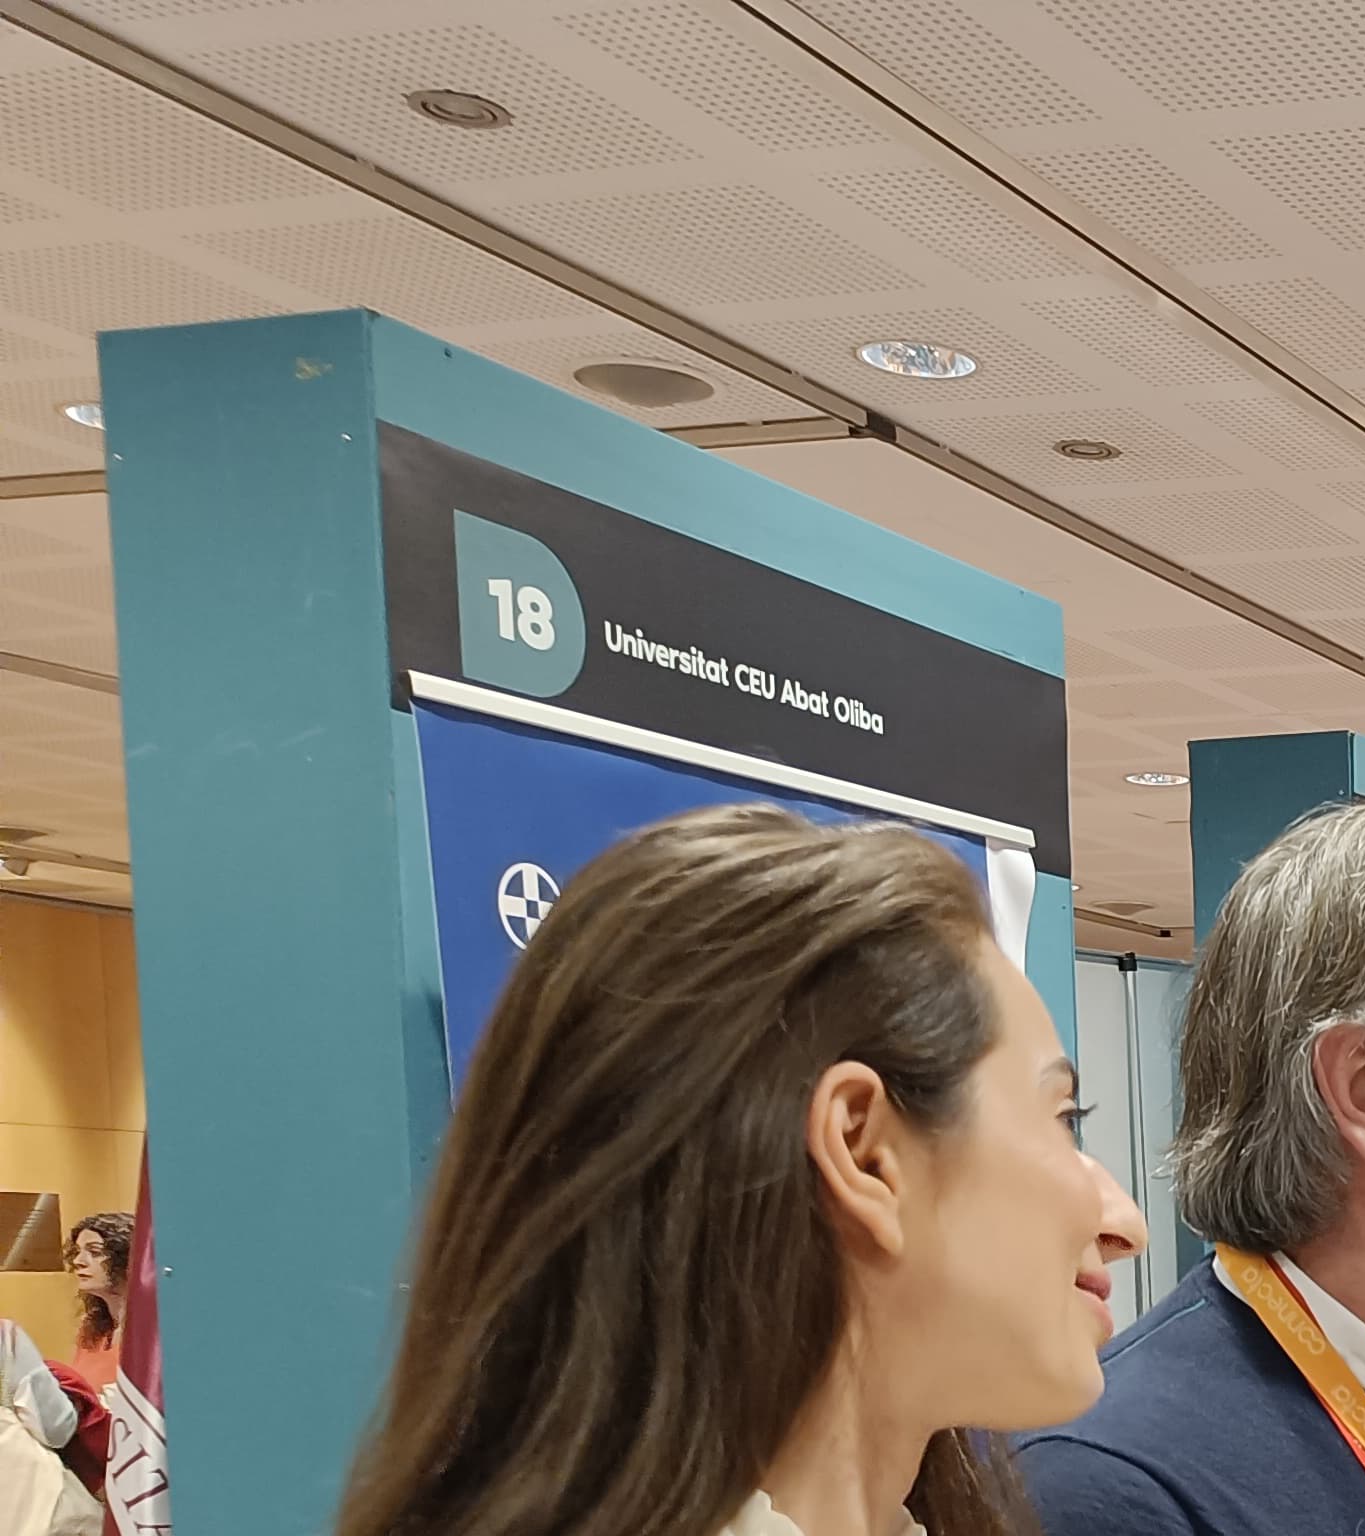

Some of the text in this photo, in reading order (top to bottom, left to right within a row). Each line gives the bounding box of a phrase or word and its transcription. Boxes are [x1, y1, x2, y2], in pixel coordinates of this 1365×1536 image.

[488, 579, 555, 651] 18
[604, 621, 884, 735] Universitat CEU Abat Oliba
[1241, 1266, 1326, 1355] connecta
